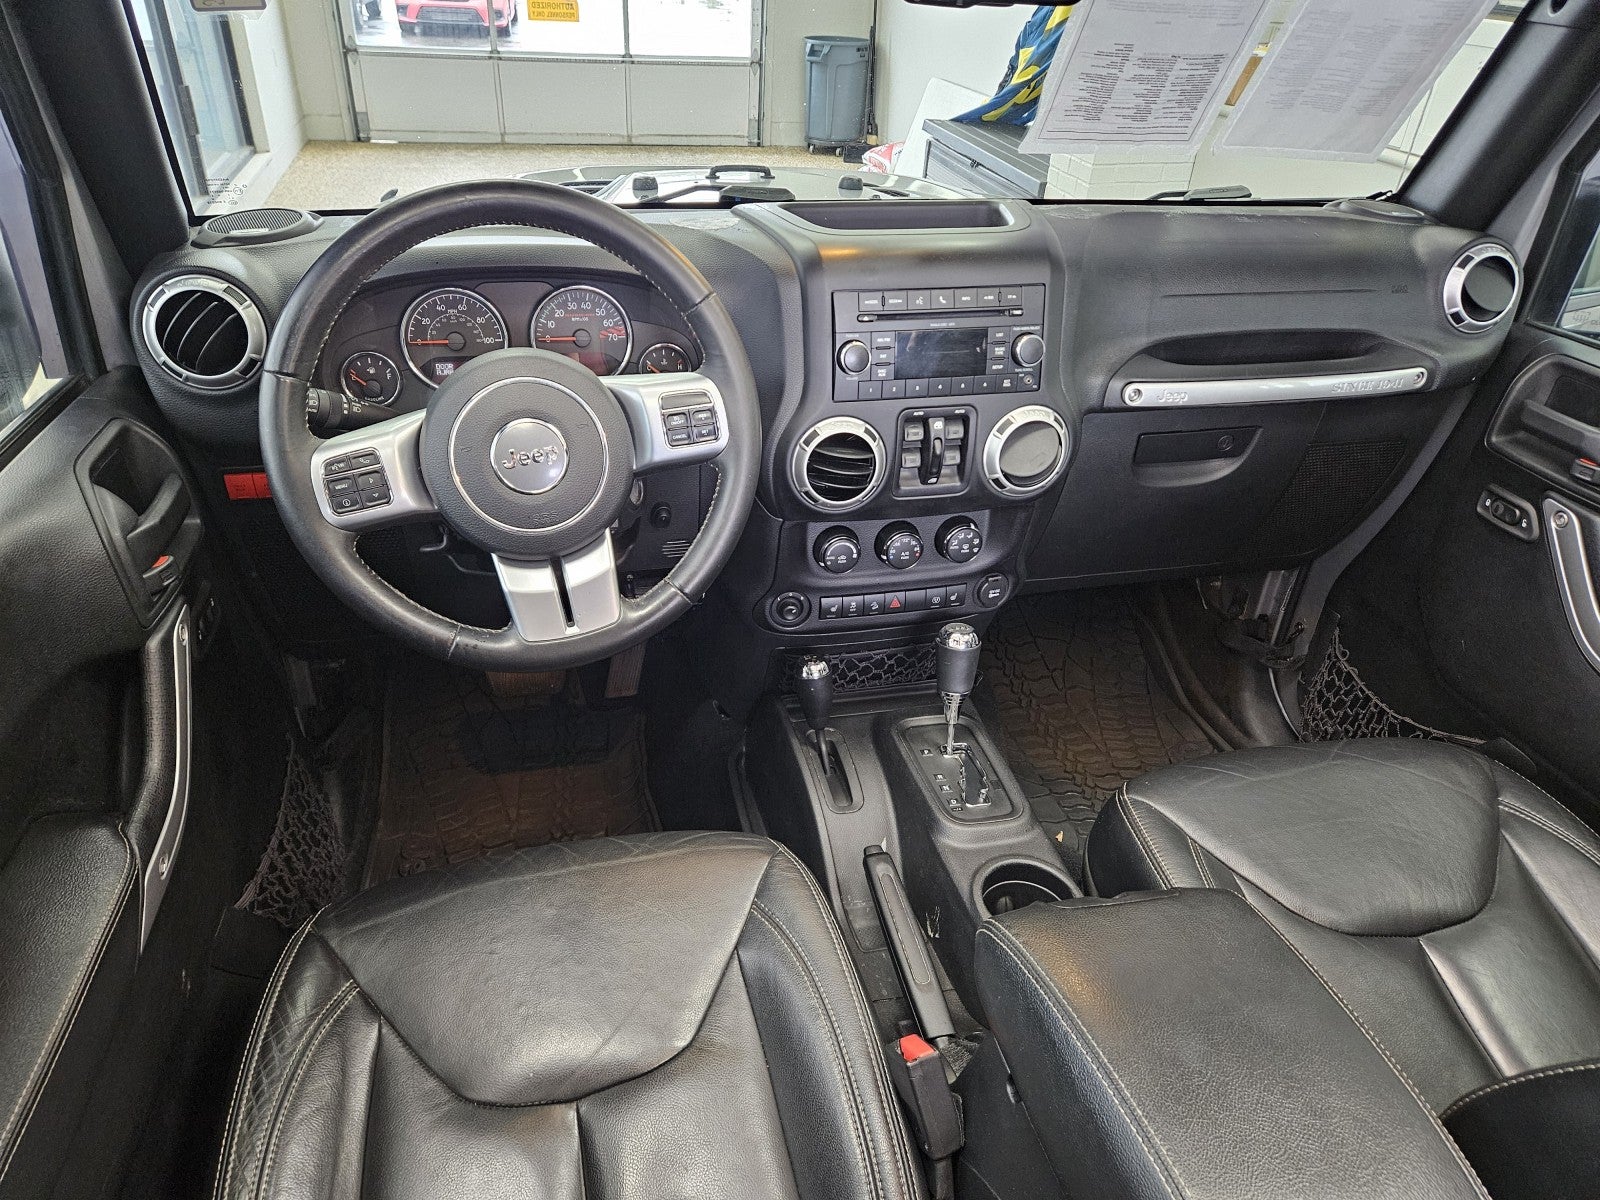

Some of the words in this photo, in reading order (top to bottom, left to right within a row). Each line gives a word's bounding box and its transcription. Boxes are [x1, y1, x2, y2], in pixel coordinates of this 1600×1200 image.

[554, 309, 565, 317] 20
[1332, 381, 1374, 393] SINCE
[1377, 379, 1404, 390] 1941
[1157, 389, 1188, 403] Jeep
[502, 445, 559, 469] Jeep
